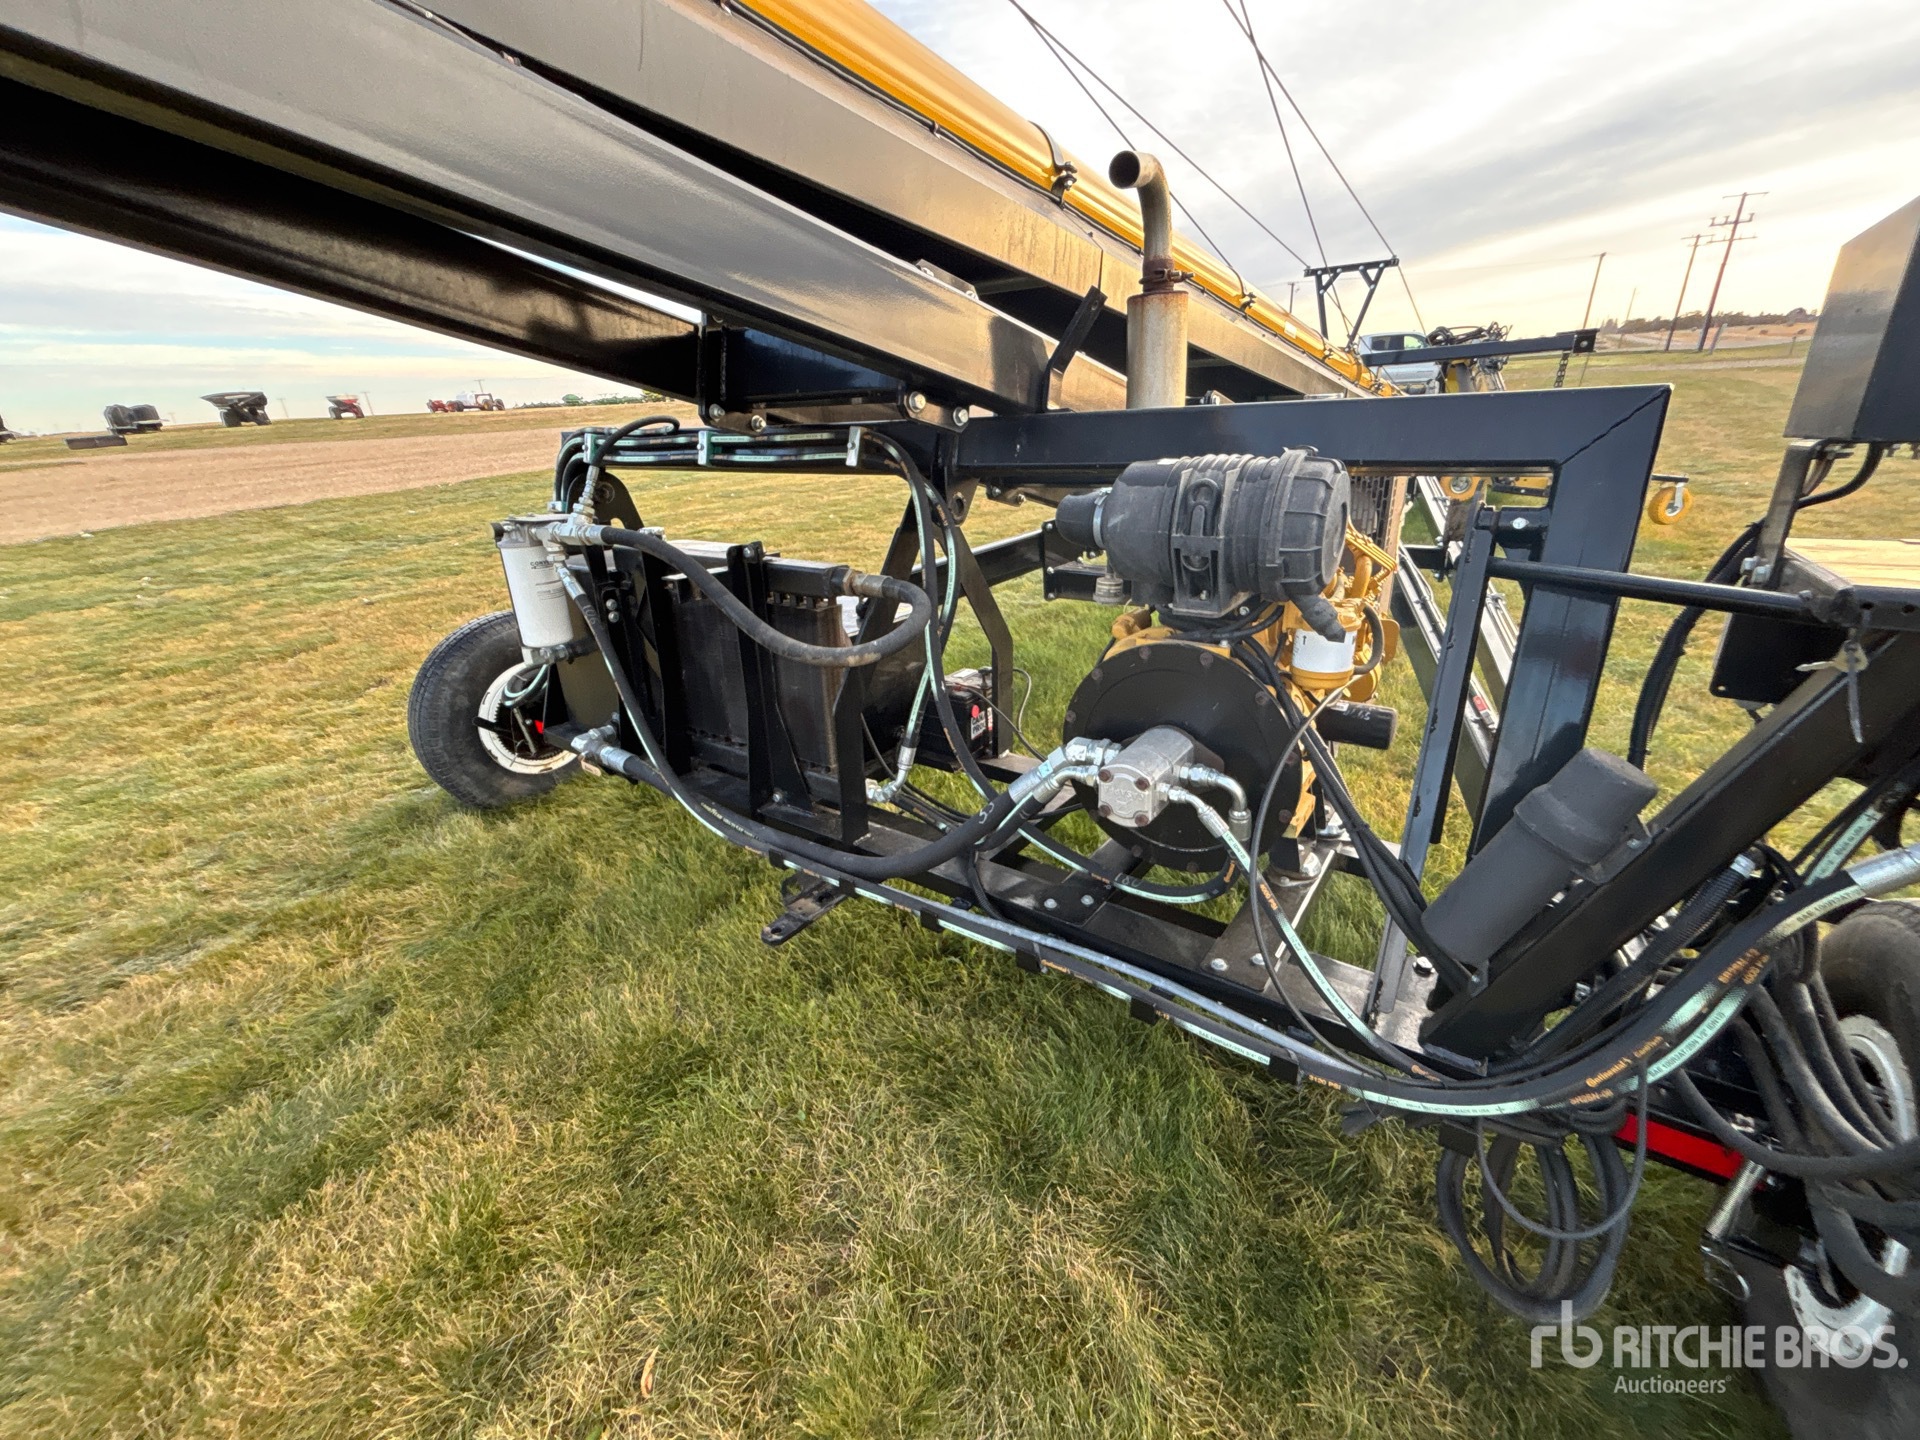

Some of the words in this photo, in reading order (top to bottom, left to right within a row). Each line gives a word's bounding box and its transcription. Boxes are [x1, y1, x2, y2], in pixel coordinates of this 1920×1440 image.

[1260, 883, 1271, 899] 4000
[1268, 898, 1278, 910] PSI
[1648, 1066, 1663, 1077] SAE
[1328, 1080, 1341, 1090] PSI
